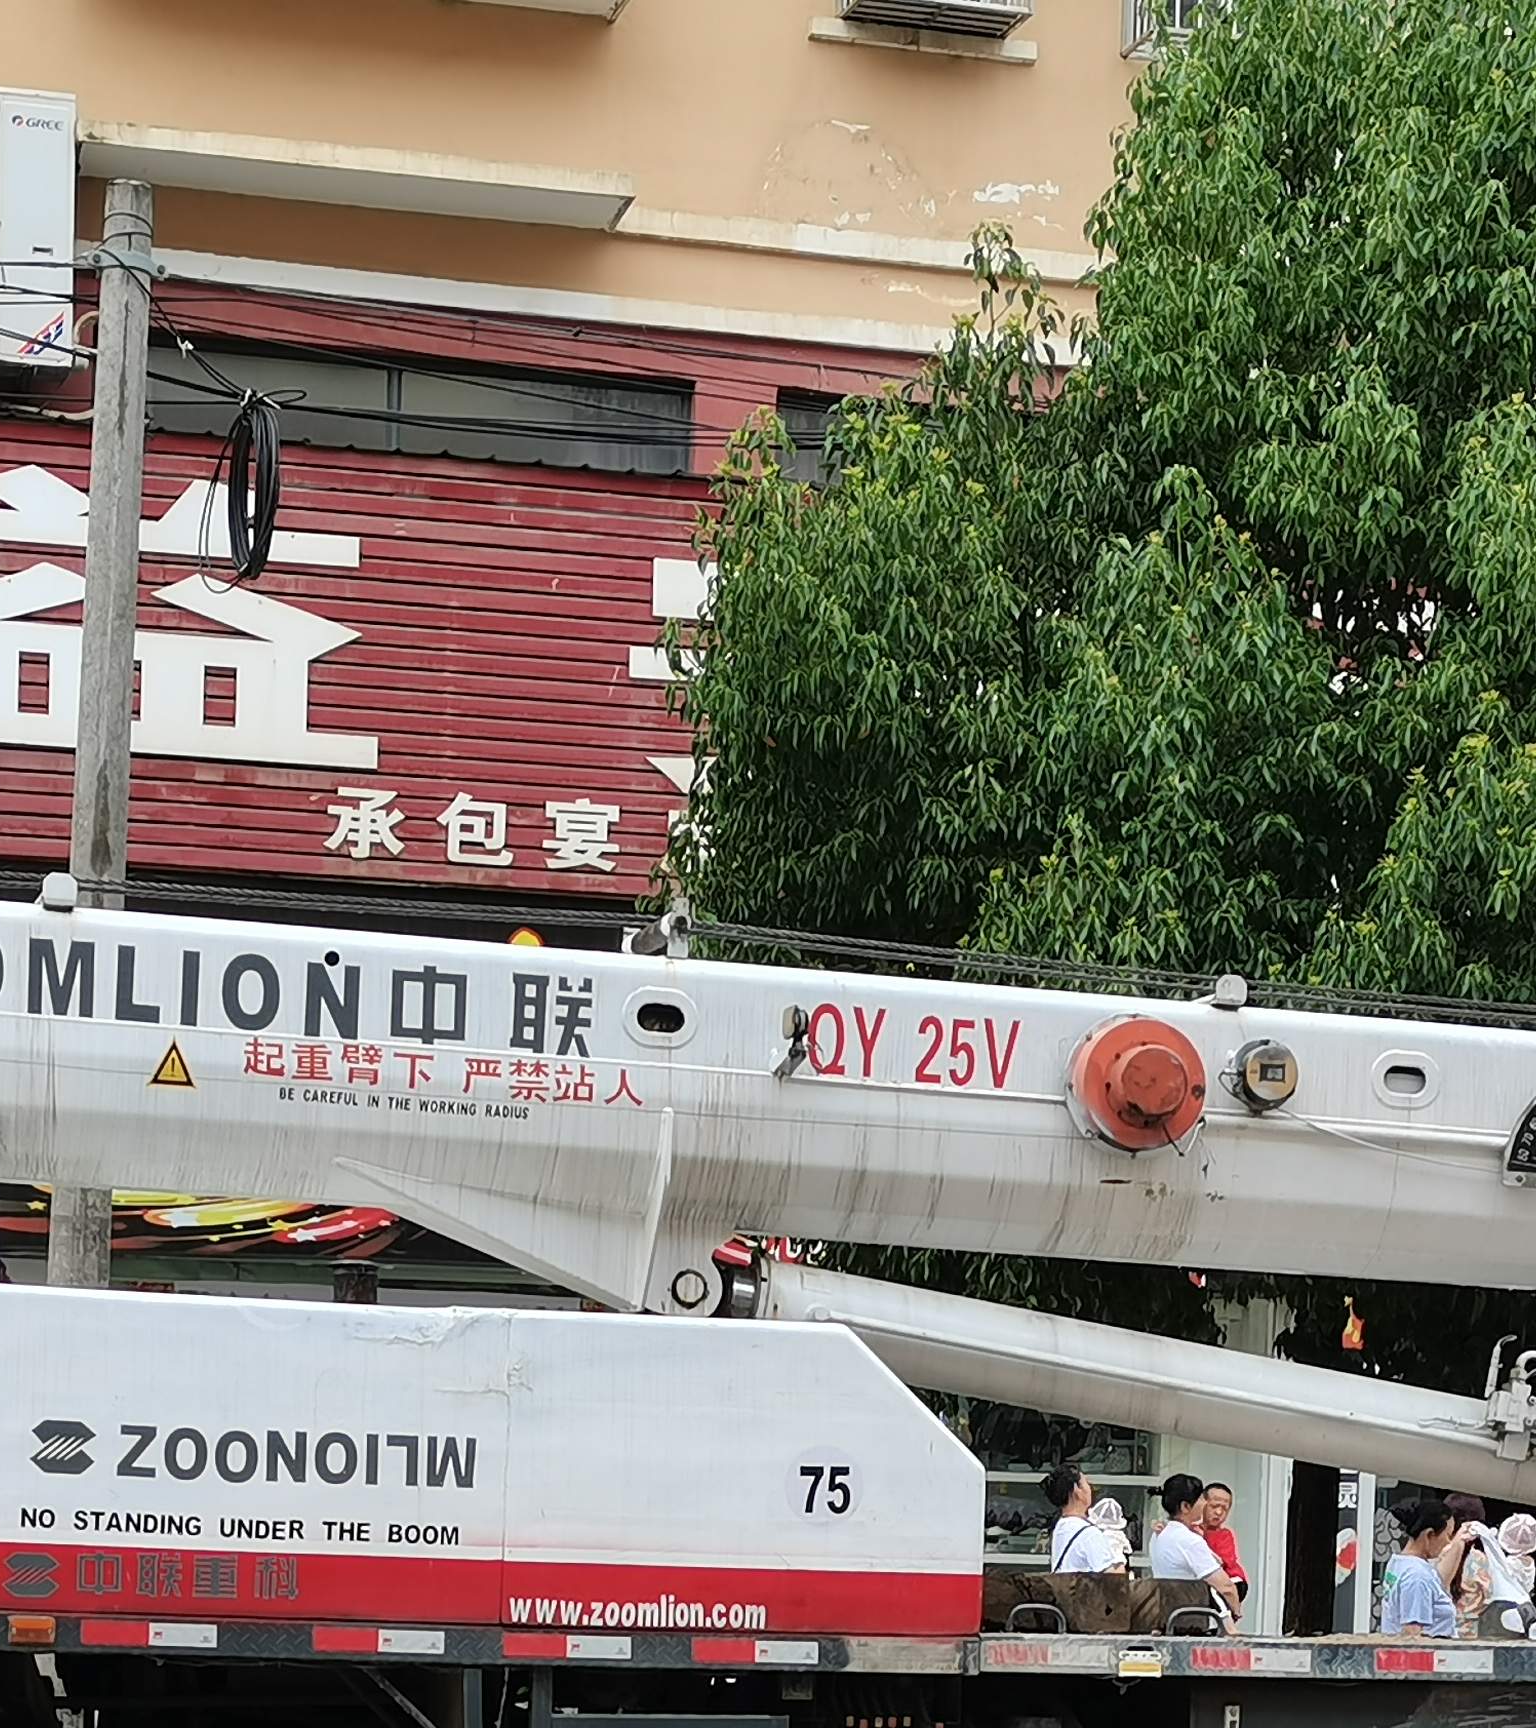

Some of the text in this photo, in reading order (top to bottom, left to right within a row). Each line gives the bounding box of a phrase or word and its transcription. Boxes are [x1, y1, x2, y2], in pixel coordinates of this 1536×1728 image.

[389, 965, 594, 1058] 中联
[243, 1036, 644, 1107] 起重臂下 严禁站人
[915, 1014, 1021, 1090] 25V
[303, 1090, 359, 1107] CAREFUL
[367, 1095, 380, 1109] IN
[388, 1096, 411, 1112] THE
[419, 1099, 477, 1118] WORKING
[485, 1104, 530, 1121] RADIUS
[798, 1465, 852, 1515] 75
[19, 1507, 460, 1546] NO STANDING UNDER THE BOOM
[75, 1551, 300, 1601] 中联重科
[509, 1595, 767, 1630] www.zoomlion.com
